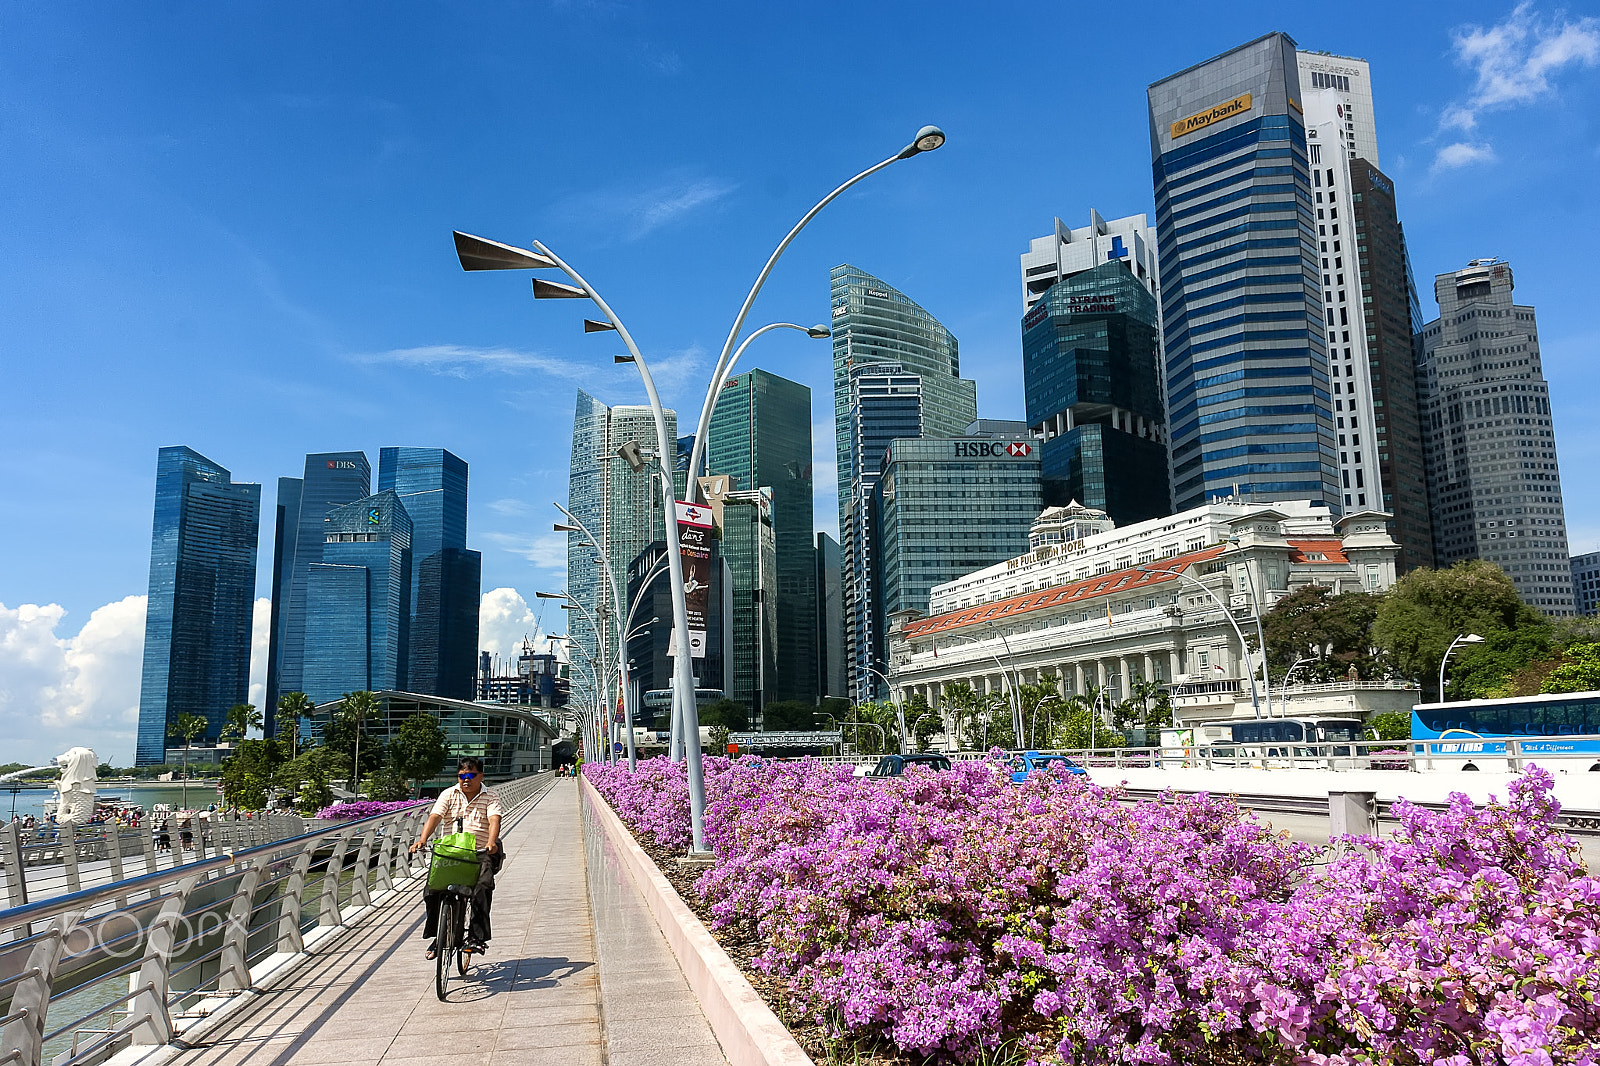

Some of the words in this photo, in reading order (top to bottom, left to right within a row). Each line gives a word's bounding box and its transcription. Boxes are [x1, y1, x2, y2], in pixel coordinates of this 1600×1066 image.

[1186, 100, 1243, 129] Maybank
[1070, 295, 1115, 304] STRAITS
[1067, 304, 1116, 314] TRADING
[953, 442, 1004, 457] HSBC
[336, 461, 356, 469] DBS
[1006, 558, 1019, 570] THE
[1020, 546, 1059, 566] FULLERTON
[1060, 539, 1086, 555] HOTEL
[1546, 743, 1574, 752] Difference
[153, 803, 170, 812] ONE
